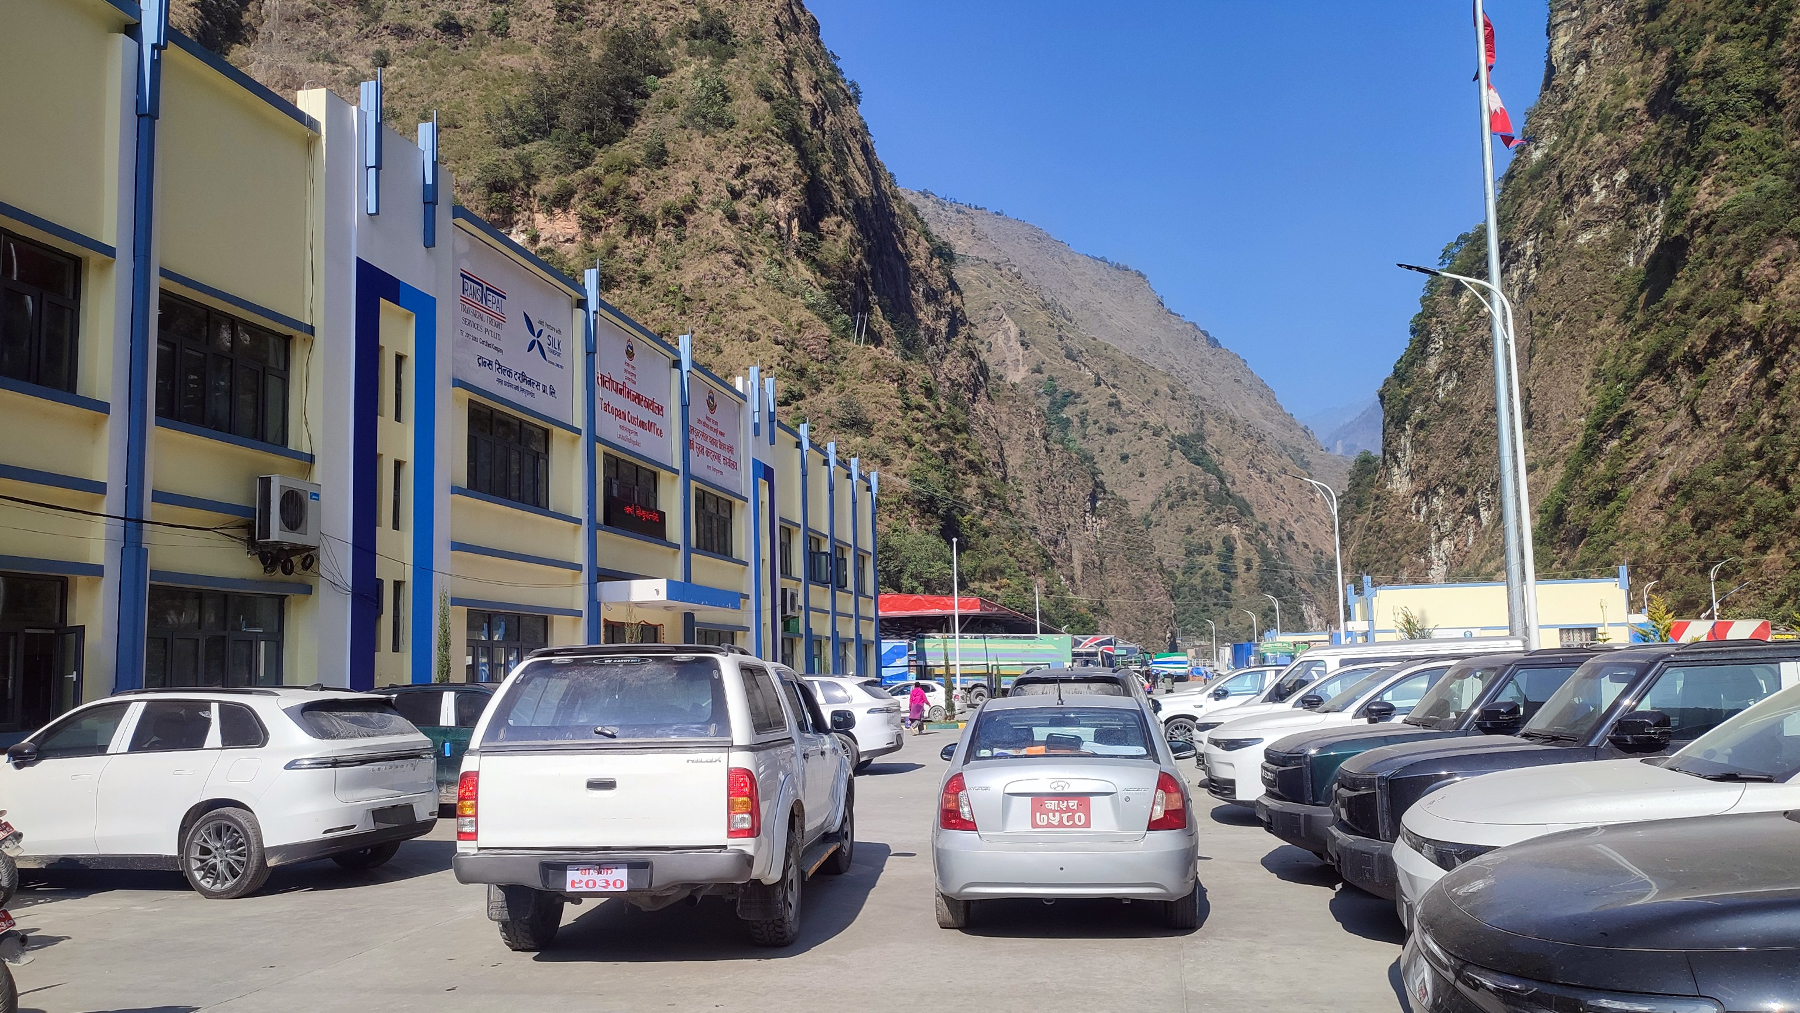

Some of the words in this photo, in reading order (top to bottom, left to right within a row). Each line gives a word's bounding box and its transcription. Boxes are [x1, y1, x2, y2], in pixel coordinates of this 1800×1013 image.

[547, 334, 562, 352] SILK
[599, 397, 627, 422] Tatopani
[1036, 812, 1086, 826] ७५८०
